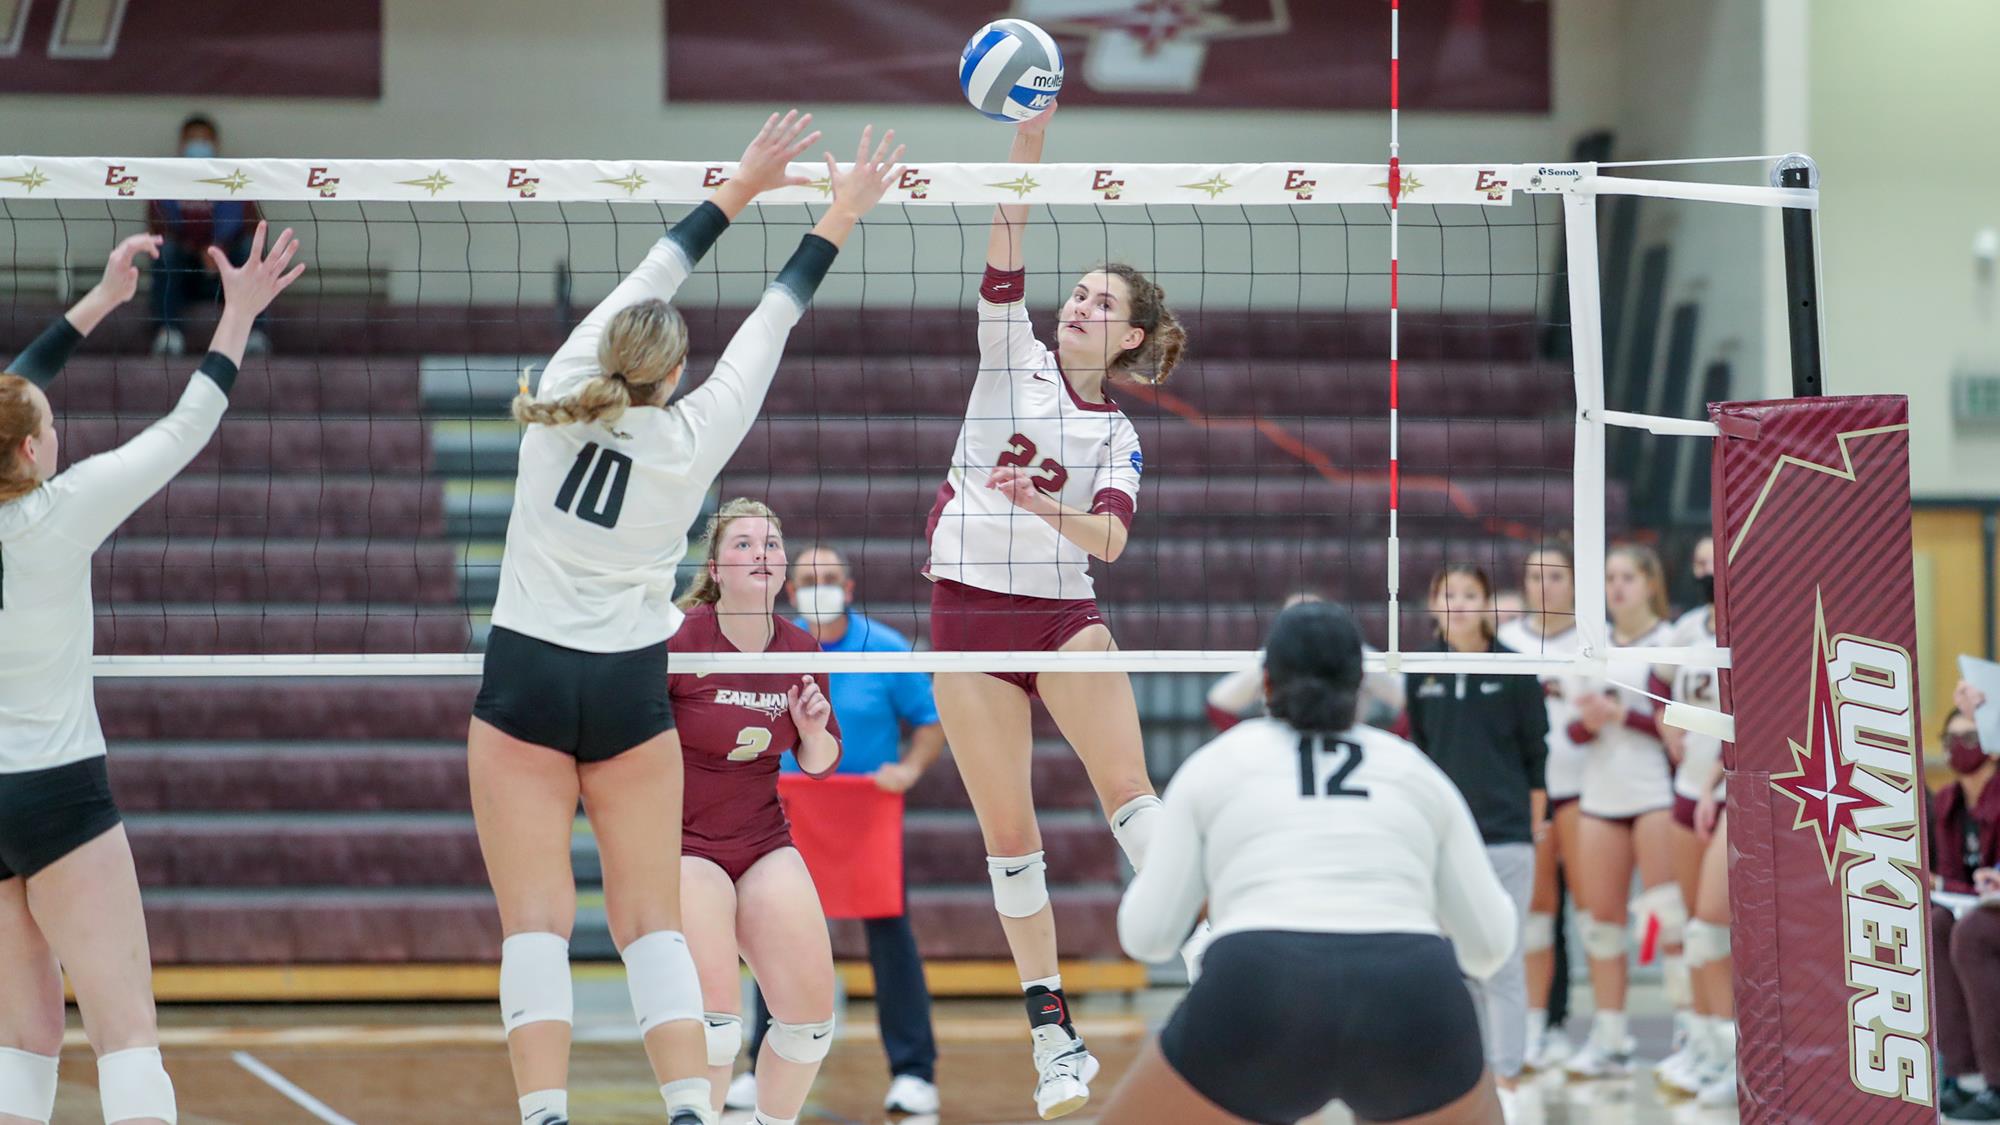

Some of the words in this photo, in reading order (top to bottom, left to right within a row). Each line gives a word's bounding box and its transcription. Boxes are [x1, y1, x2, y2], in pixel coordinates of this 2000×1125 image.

[1033, 75, 1062, 88] molte
[1547, 168, 1579, 176] Senoh
[554, 441, 633, 529] 10
[997, 433, 1068, 493] 22
[727, 727, 772, 761] 2
[1299, 737, 1368, 797] 12
[1828, 634, 1932, 1106] QUAKERS
